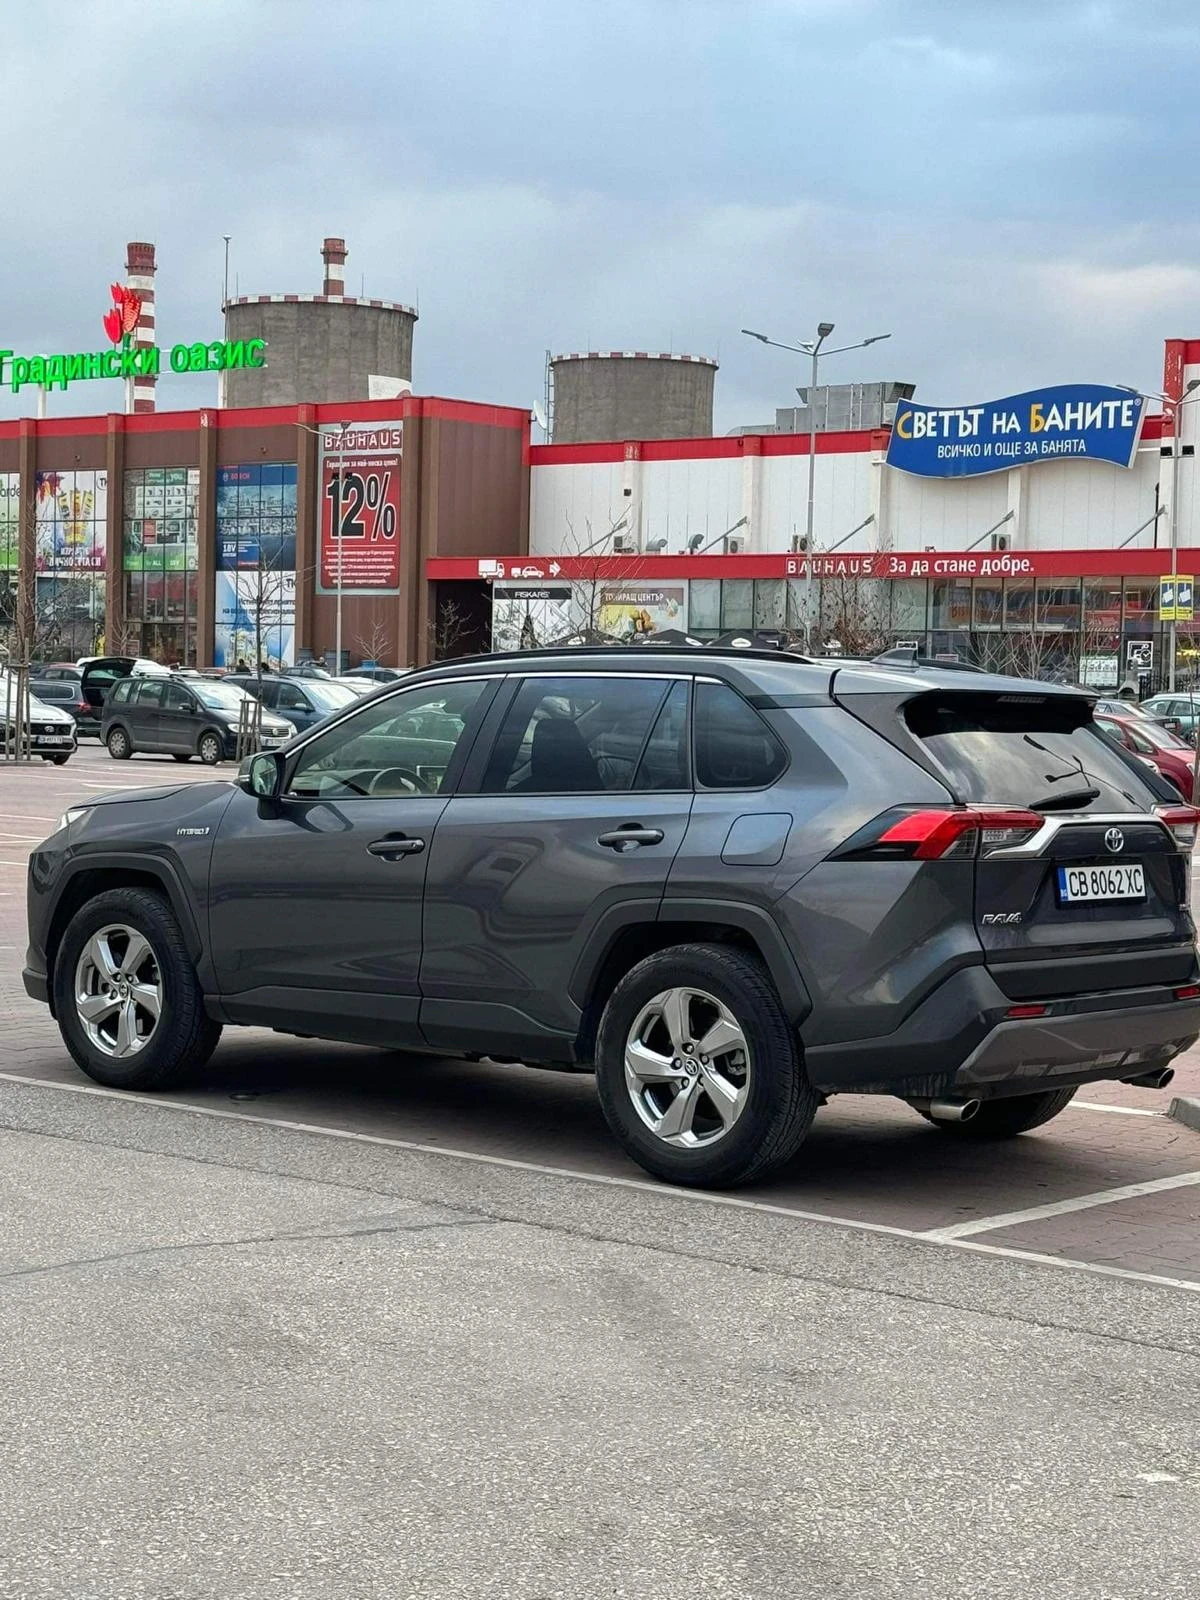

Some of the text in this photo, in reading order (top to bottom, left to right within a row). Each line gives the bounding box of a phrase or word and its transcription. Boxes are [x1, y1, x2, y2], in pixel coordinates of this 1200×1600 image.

[0, 337, 266, 393] Градински оазис
[896, 408, 984, 439] СВЕТЪТ
[1030, 399, 1133, 433] БАНИТЕ
[324, 431, 401, 448] BAUHAUS
[937, 439, 1086, 458] ВСИЧКО И ОЩЕ ЗА БАНЯТА
[326, 471, 397, 542] 12%
[787, 558, 872, 574] BAUHAUS
[889, 555, 1035, 577] За да стане добре.
[514, 591, 549, 599] FISKARS
[1069, 868, 1143, 896] CB 8062 XC
[981, 911, 1022, 925] RAV4
